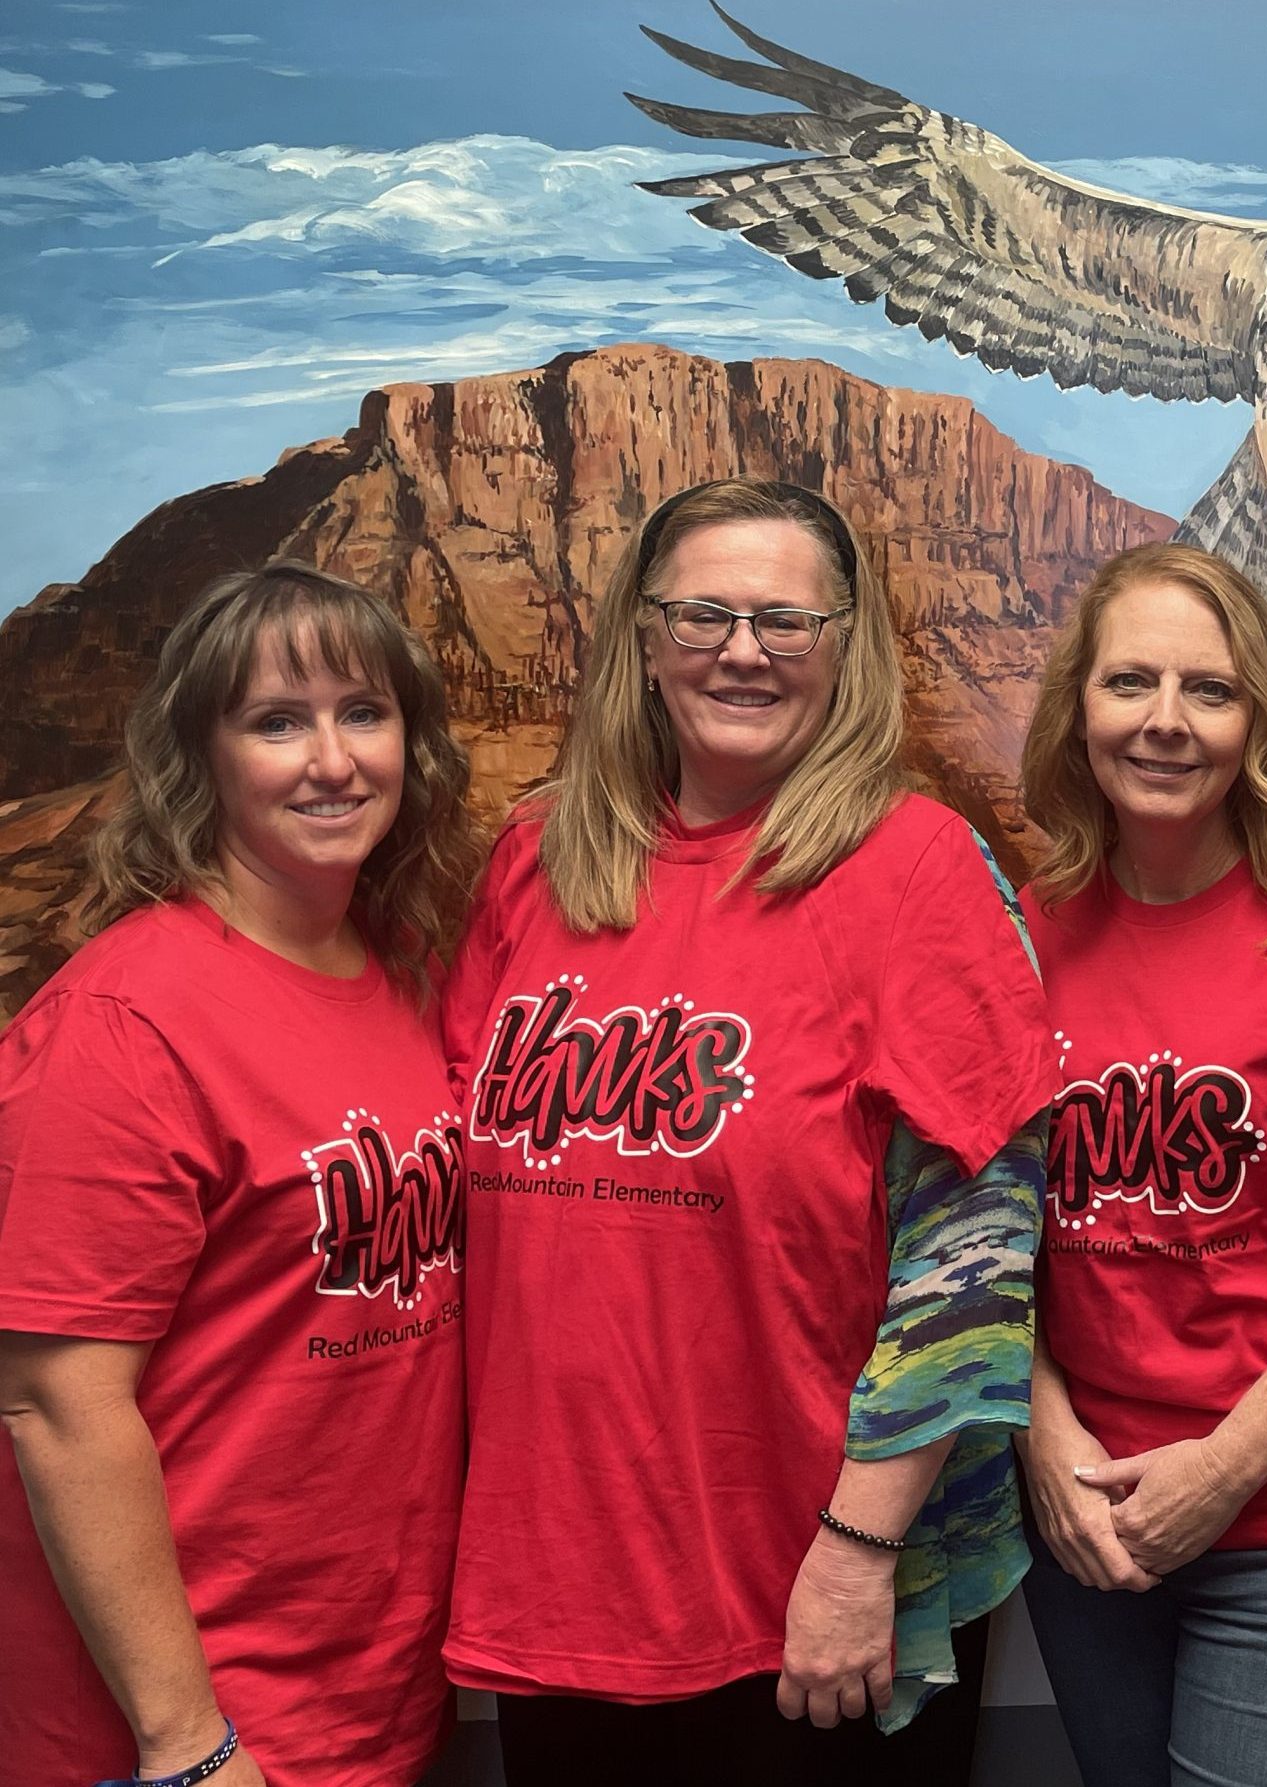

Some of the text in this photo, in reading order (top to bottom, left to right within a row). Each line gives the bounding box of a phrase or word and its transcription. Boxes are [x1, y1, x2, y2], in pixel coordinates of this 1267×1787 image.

[478, 988, 744, 1150] Hawks
[499, 1171, 585, 1198] Mountain
[593, 1177, 725, 1214] Elementary
[308, 1332, 358, 1360] Red
